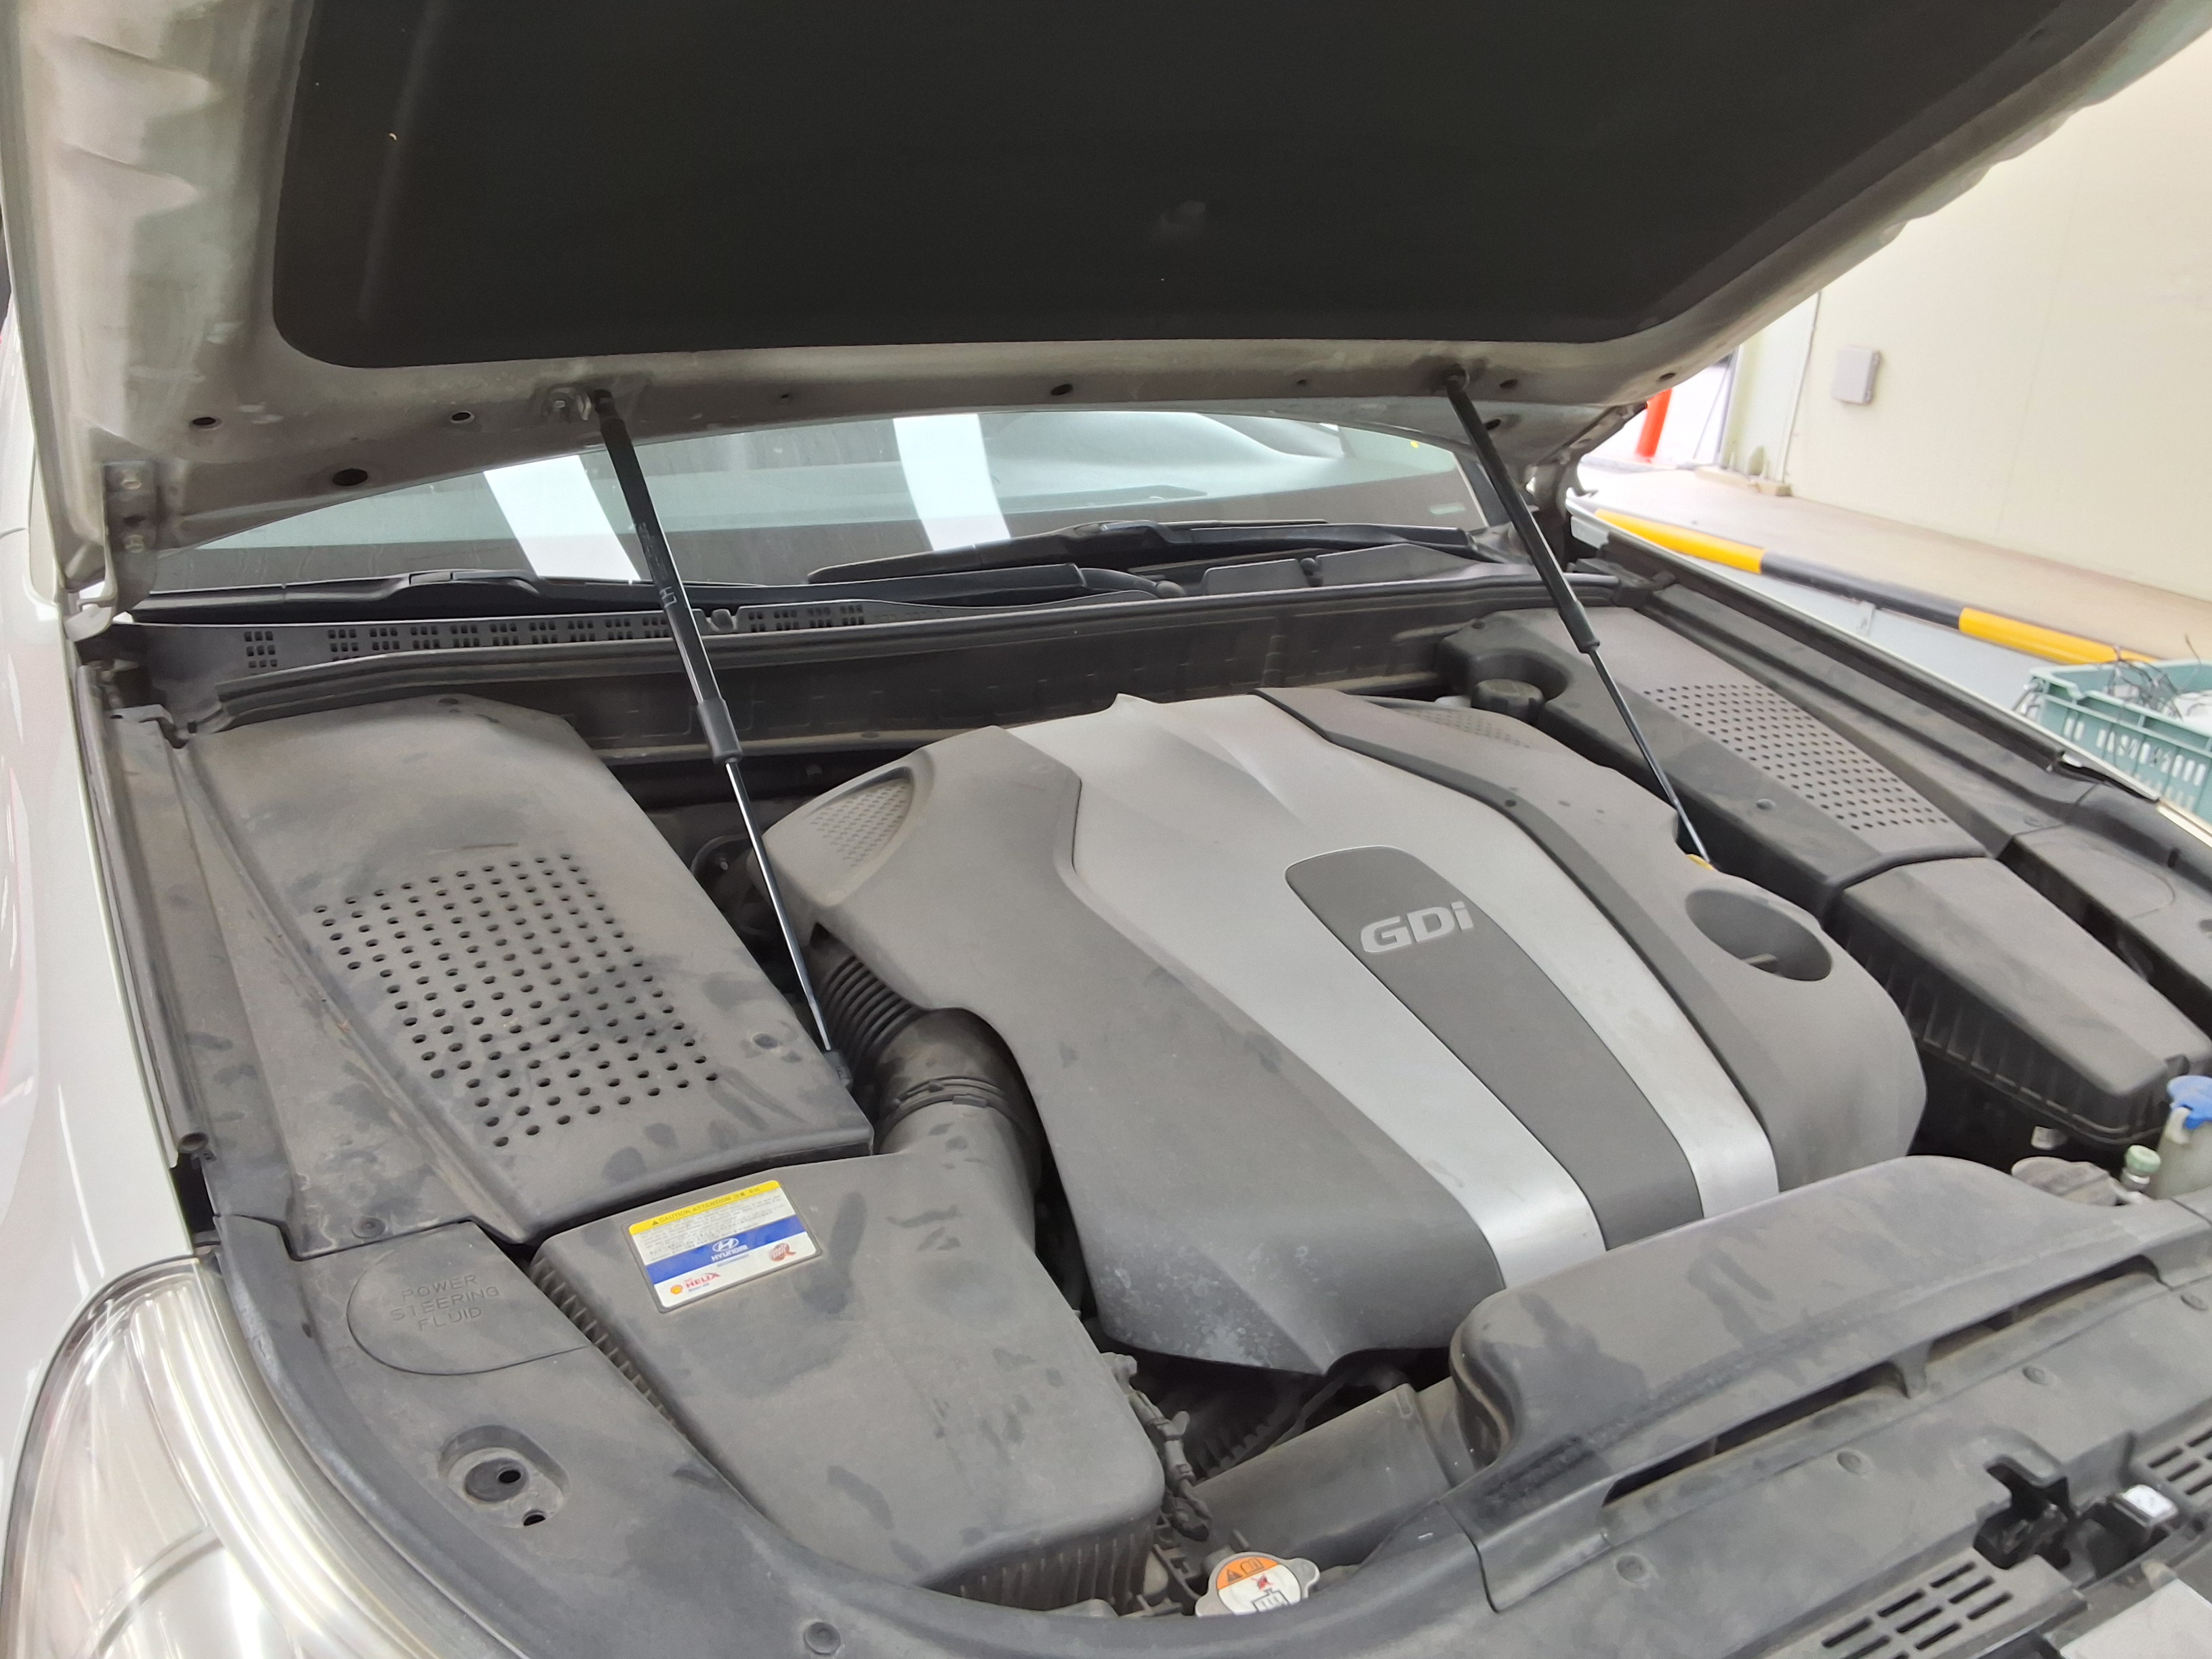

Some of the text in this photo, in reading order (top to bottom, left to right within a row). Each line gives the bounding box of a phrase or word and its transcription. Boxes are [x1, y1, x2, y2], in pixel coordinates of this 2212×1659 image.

[1360, 901, 1474, 953] GDi
[659, 1196, 731, 1223] CAUTION ATTENTION
[402, 1274, 477, 1300] POWER
[684, 1273, 721, 1289] HELIX
[390, 1286, 499, 1322] STEERING
[418, 1307, 482, 1332] FLUID
